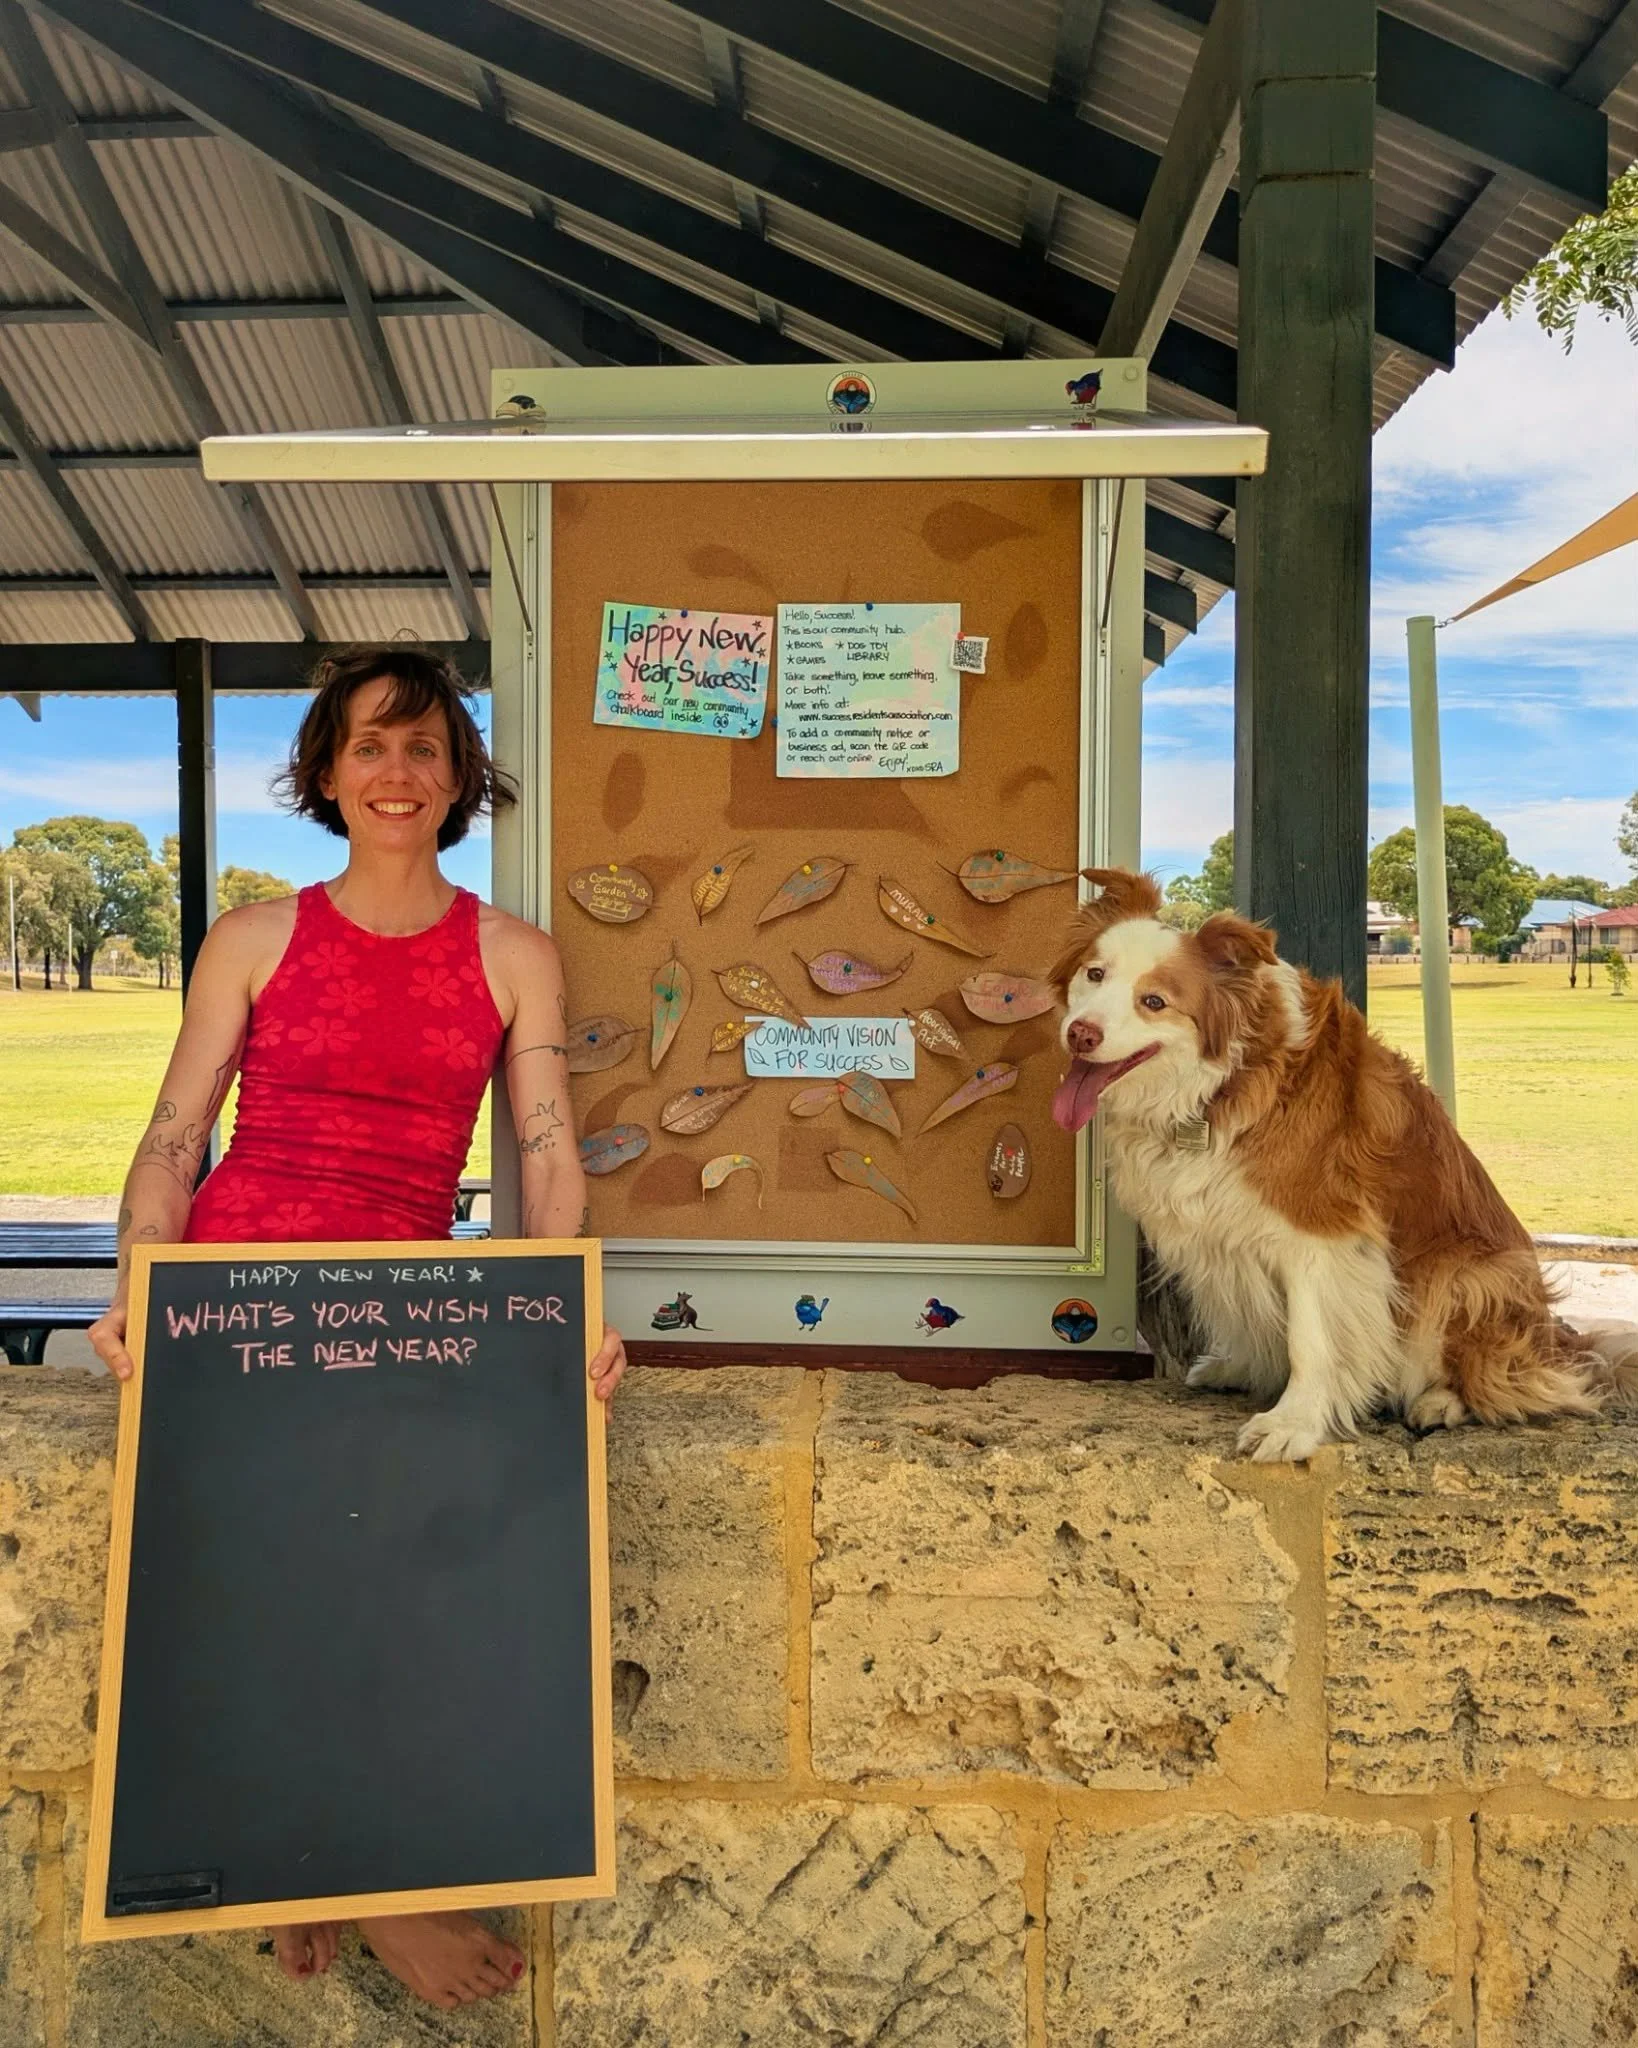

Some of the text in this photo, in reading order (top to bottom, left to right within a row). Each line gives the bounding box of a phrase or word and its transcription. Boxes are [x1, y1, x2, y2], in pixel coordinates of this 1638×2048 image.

[785, 608, 856, 624] Hello, Success!
[608, 610, 767, 662] Happy New
[783, 625, 801, 635] This
[830, 624, 879, 637] community
[794, 640, 824, 650] BOOKS
[847, 641, 888, 651] DOG TOY
[795, 655, 827, 665] GAMES
[846, 650, 890, 662] LIBRARY
[624, 652, 758, 695] Year, Success!
[784, 671, 806, 681] Take
[862, 671, 886, 681] leave
[785, 686, 799, 695] or
[606, 689, 635, 701] Check
[641, 693, 656, 703] out
[662, 696, 680, 706] our
[702, 702, 749, 720] community
[609, 702, 665, 719] chalkboard
[784, 699, 807, 710] More
[811, 698, 830, 710] info
[786, 726, 931, 742] To add a community notice or
[787, 741, 828, 752] business
[849, 743, 871, 751] scan
[873, 742, 888, 751] the
[891, 741, 907, 751] QR
[909, 740, 929, 750] code
[785, 754, 797, 762] or
[799, 753, 825, 763] reach
[828, 754, 846, 763] out
[754, 1023, 840, 1049] COMMUNITY
[846, 1021, 900, 1047] VISION
[917, 1028, 938, 1049] Art
[774, 1048, 883, 1073] FOR SUCCESS
[230, 1265, 456, 1289] HAPPY NEW YEAR!
[166, 1295, 568, 1340] WHAT'S YOUR WISH FOR
[231, 1336, 478, 1374] THE NEW YEAR?
